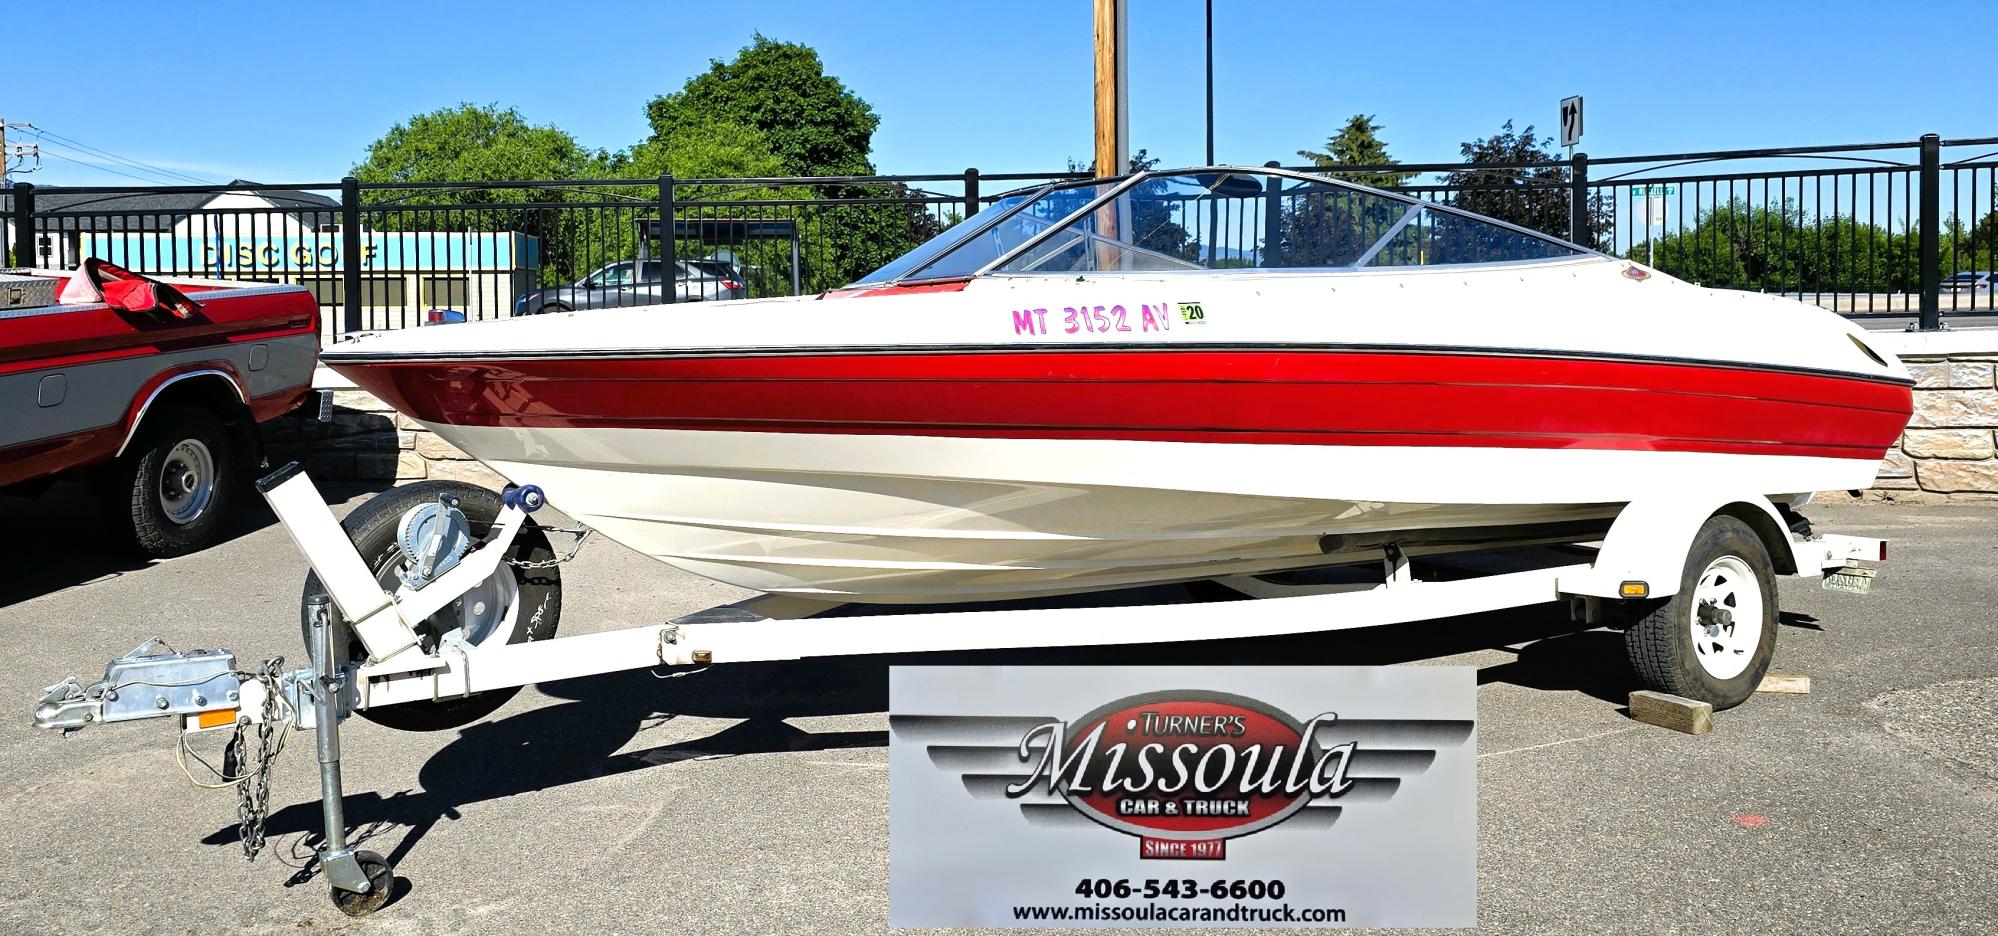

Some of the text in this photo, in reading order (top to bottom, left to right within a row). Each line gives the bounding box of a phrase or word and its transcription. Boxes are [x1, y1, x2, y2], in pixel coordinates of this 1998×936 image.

[202, 243, 378, 268] DISC GOF
[1012, 308, 1048, 336] MT
[1064, 304, 1132, 334] 3152
[1141, 302, 1170, 333] AV
[1186, 305, 1204, 320] 20
